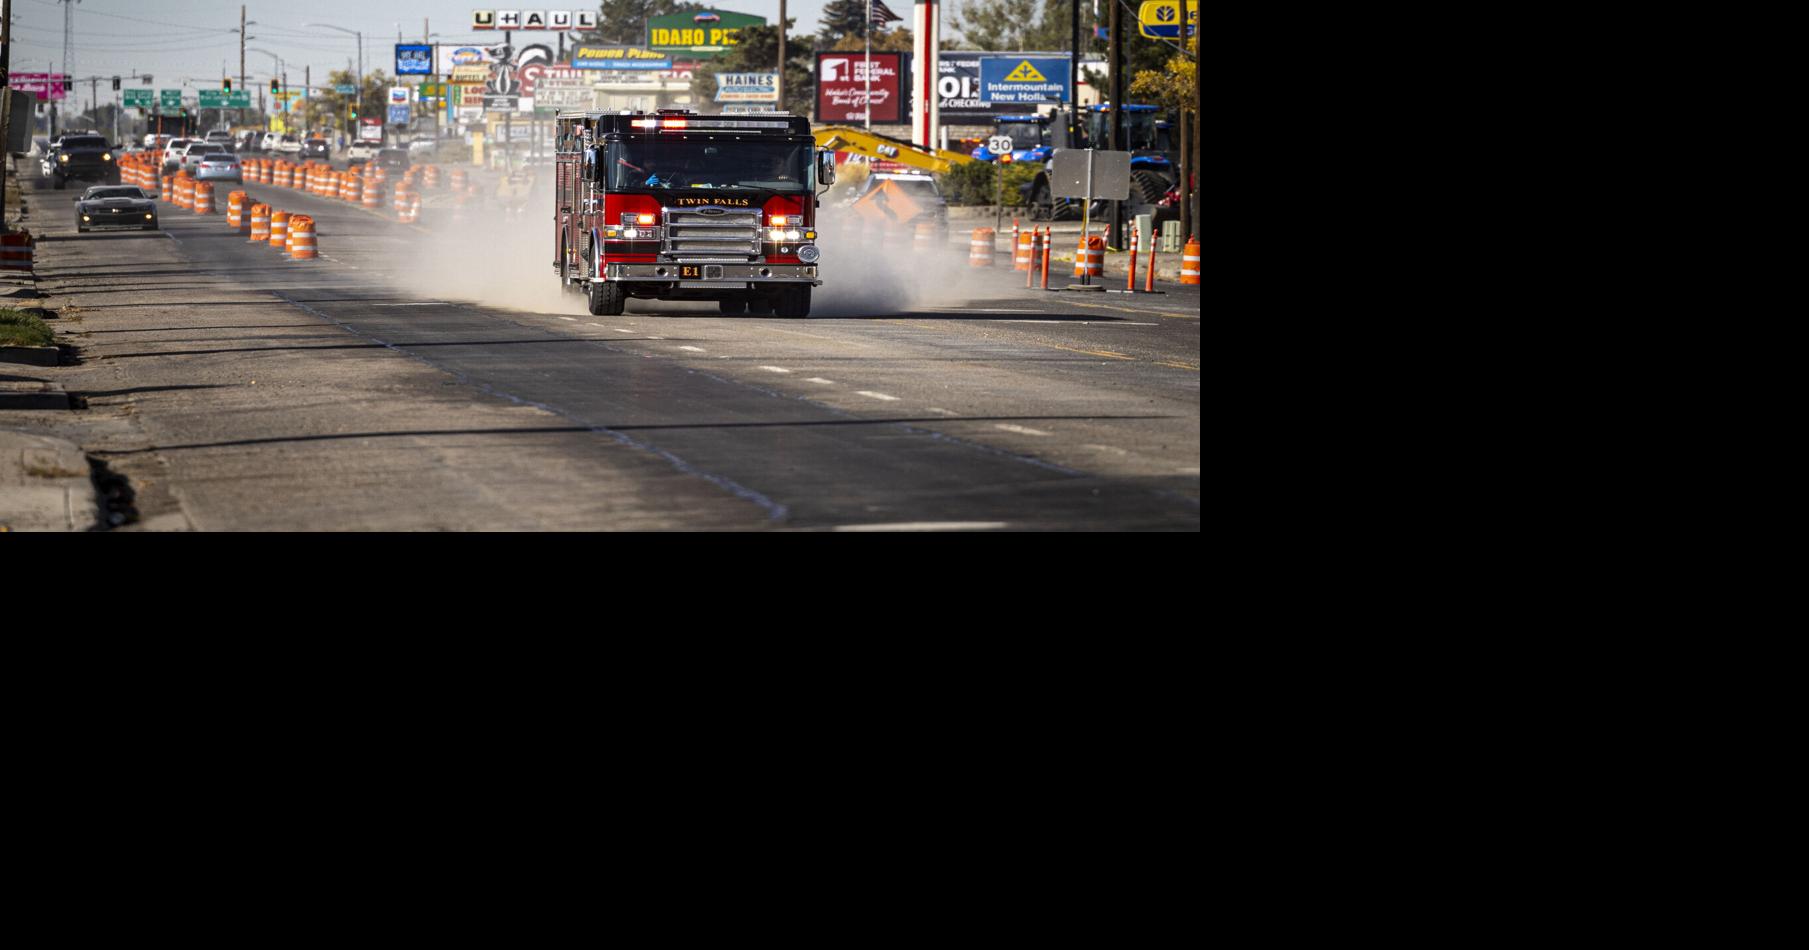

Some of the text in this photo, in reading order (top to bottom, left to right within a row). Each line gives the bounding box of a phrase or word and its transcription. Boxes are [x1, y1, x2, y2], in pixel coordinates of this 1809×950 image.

[652, 28, 705, 46] IDAHO
[726, 75, 773, 85] HAINES
[988, 82, 1064, 91] Intermountain
[991, 92, 1015, 101] New
[877, 144, 897, 157] CAT
[991, 140, 1010, 151] 30
[683, 266, 698, 277] E1
